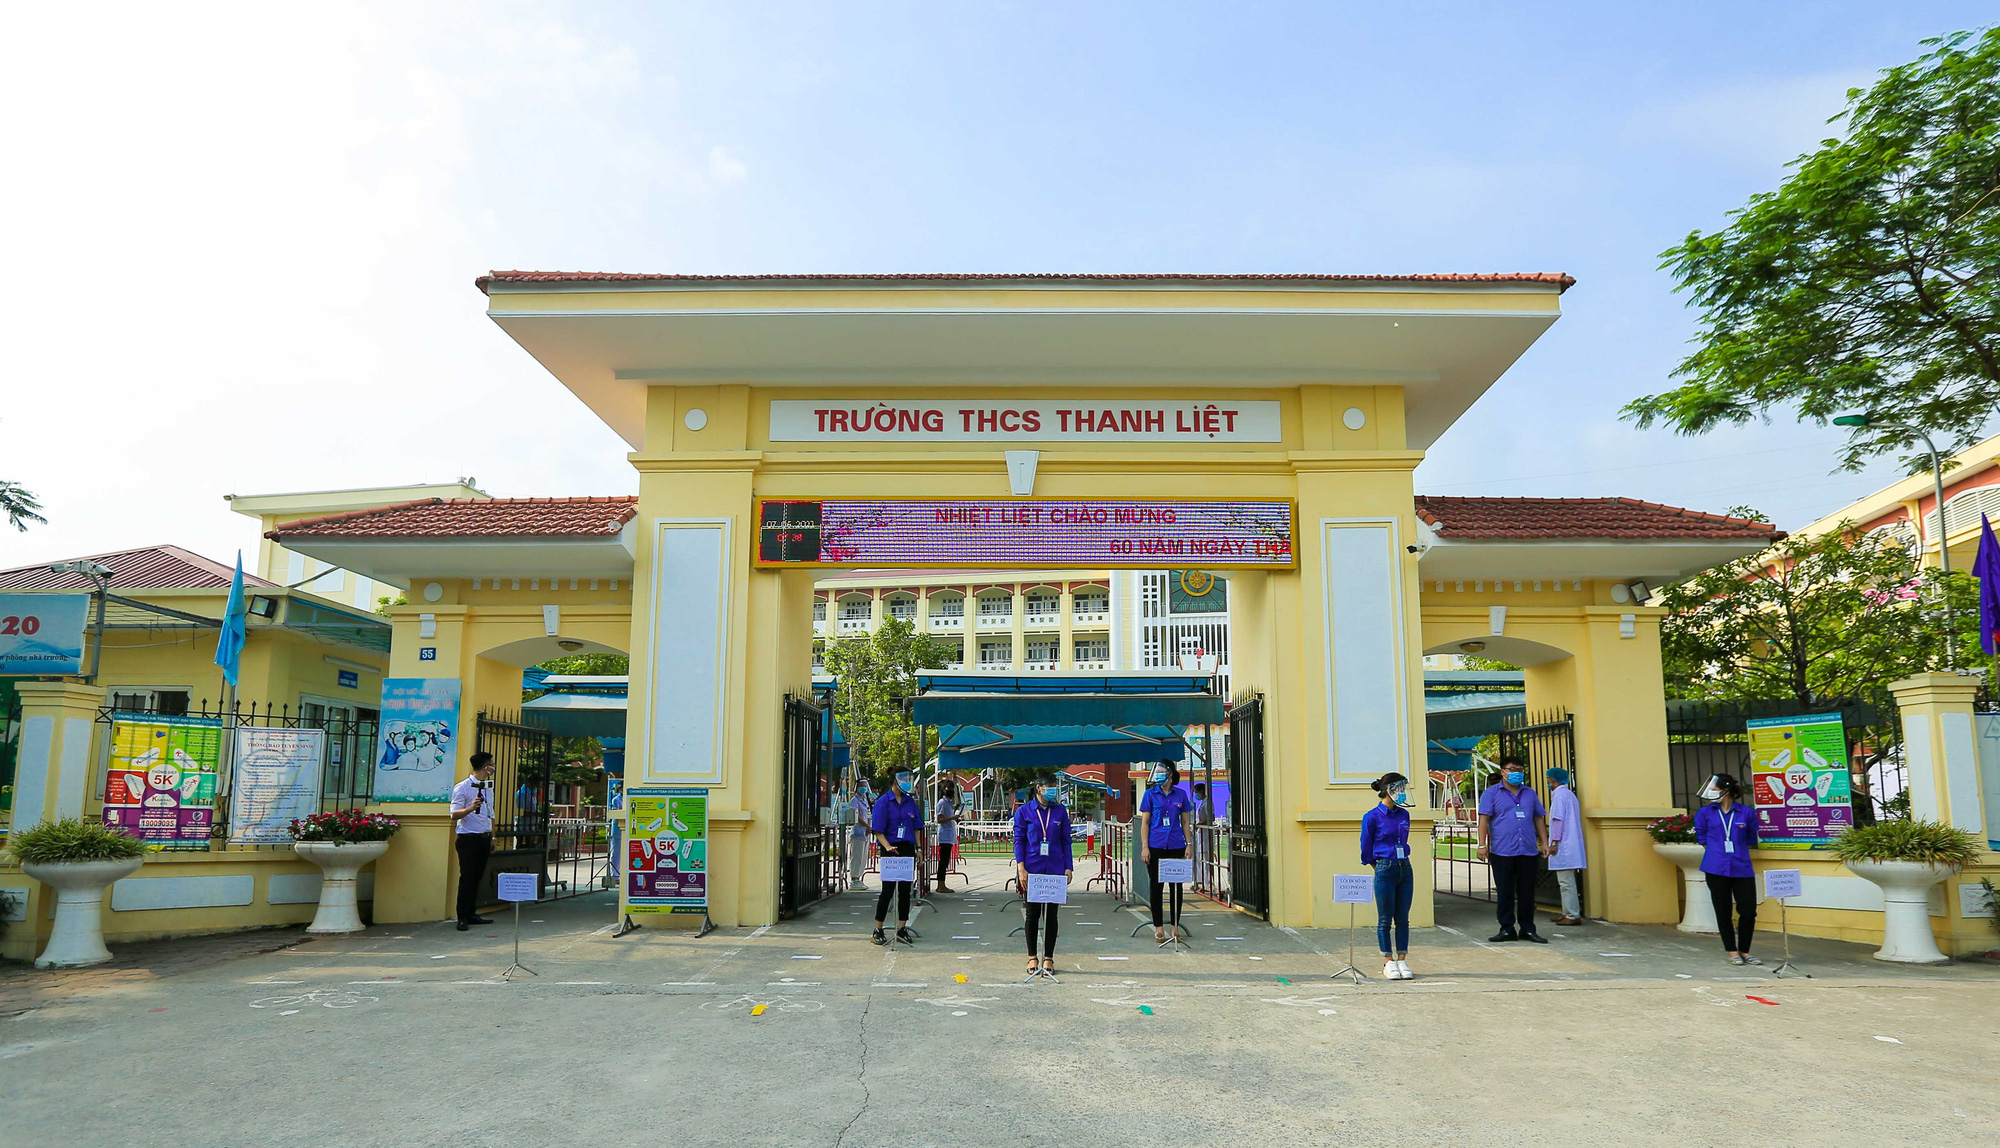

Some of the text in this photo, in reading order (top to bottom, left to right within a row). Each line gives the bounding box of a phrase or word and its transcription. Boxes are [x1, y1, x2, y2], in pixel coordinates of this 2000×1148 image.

[814, 402, 944, 432] TRƯỜNG
[958, 409, 1041, 432] THCS
[1056, 409, 1164, 432] THANH
[936, 504, 1176, 527] NHIỆT LIỆT CHÀO MỪNG
[1109, 539, 1133, 555] 60
[1139, 536, 1184, 555] NĂM
[1190, 536, 1247, 555] NGÀY
[0, 614, 41, 636] 20
[421, 649, 434, 659] 55
[154, 774, 173, 785] 5K
[1790, 774, 1808, 785] 5K
[142, 819, 176, 828] 19009095
[1788, 818, 1817, 826] 19009095
[659, 841, 675, 851] 5K
